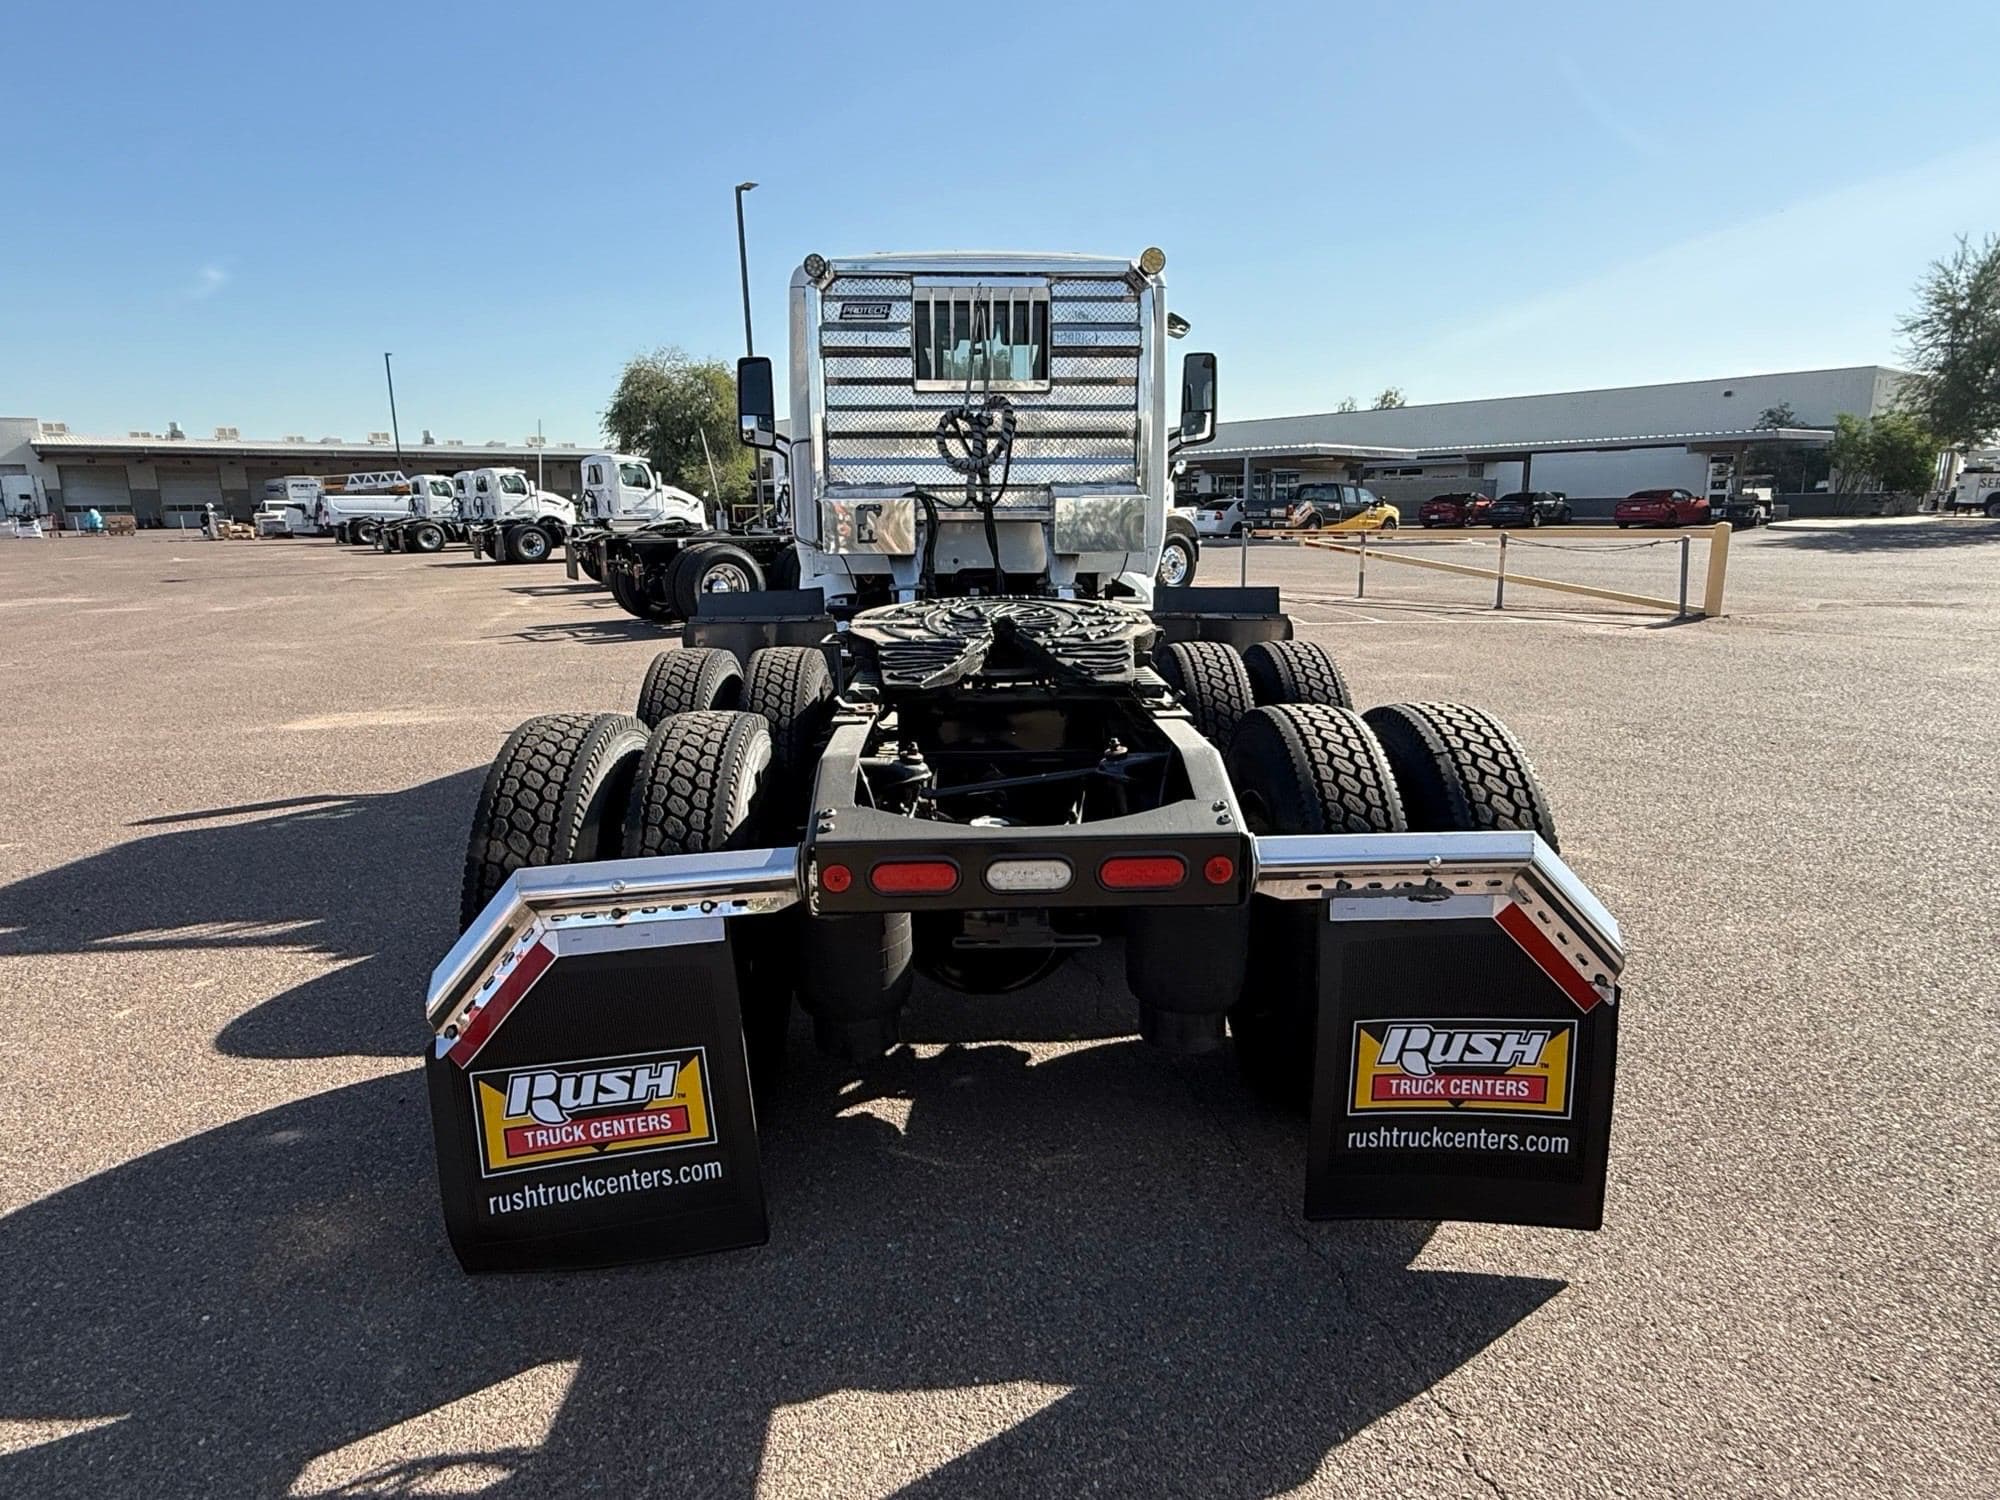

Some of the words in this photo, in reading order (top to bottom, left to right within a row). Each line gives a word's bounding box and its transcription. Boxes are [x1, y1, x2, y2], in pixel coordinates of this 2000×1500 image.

[842, 304, 889, 314] PROTECH
[1377, 1025, 1549, 1076] RUSH
[504, 1062, 679, 1125] RUSH
[1390, 1079, 1445, 1095] TRUCK
[1450, 1080, 1530, 1096] CENTERS
[524, 1125, 586, 1149] TRUCK
[590, 1113, 672, 1139] CENTERS
[1348, 1126, 1569, 1154] rushtruckcenters.com
[489, 1160, 722, 1215] rushtruckcenters.com
